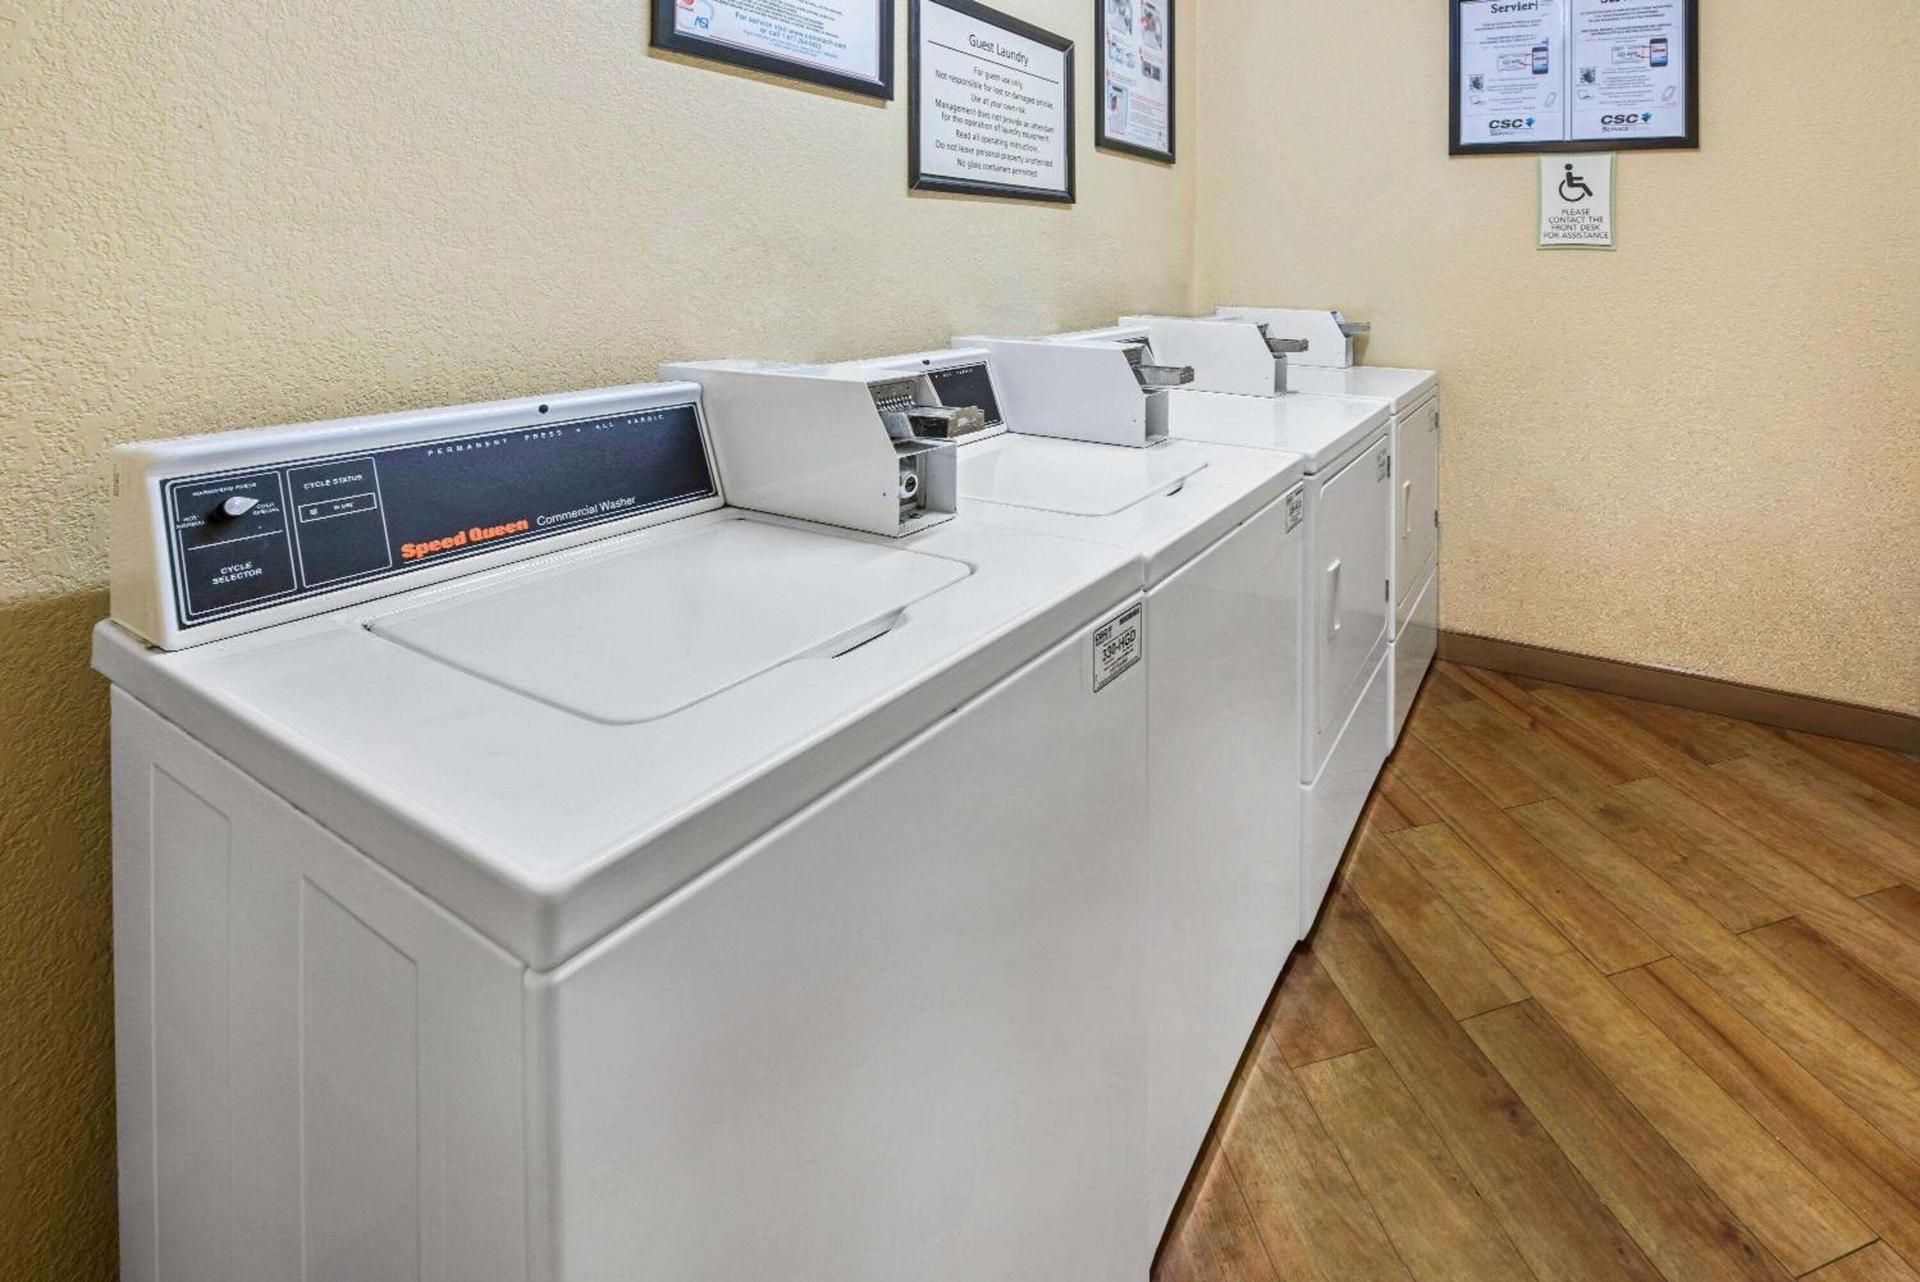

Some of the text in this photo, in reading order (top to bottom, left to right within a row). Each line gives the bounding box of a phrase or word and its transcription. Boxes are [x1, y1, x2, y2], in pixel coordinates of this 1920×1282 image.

[968, 34, 1029, 68] Guest Laundry
[935, 69, 947, 80] Not
[974, 66, 984, 76] For
[935, 98, 977, 114] Management
[942, 112, 951, 121] for
[1601, 113, 1638, 124] CSC
[1489, 118, 1524, 129] CSC
[956, 129, 971, 140] Read
[935, 139, 945, 149] Do
[957, 158, 966, 167] No
[1548, 216, 1586, 224] CONTACT
[428, 438, 508, 456] PERMANENT
[524, 430, 563, 441] PRESS
[595, 422, 614, 430] ALL
[303, 474, 363, 490] CYCLE STATUS
[401, 496, 636, 559] Speed Queen Commercial Washer
[221, 561, 252, 574] CYCLE
[212, 568, 263, 584] SELECTOR
